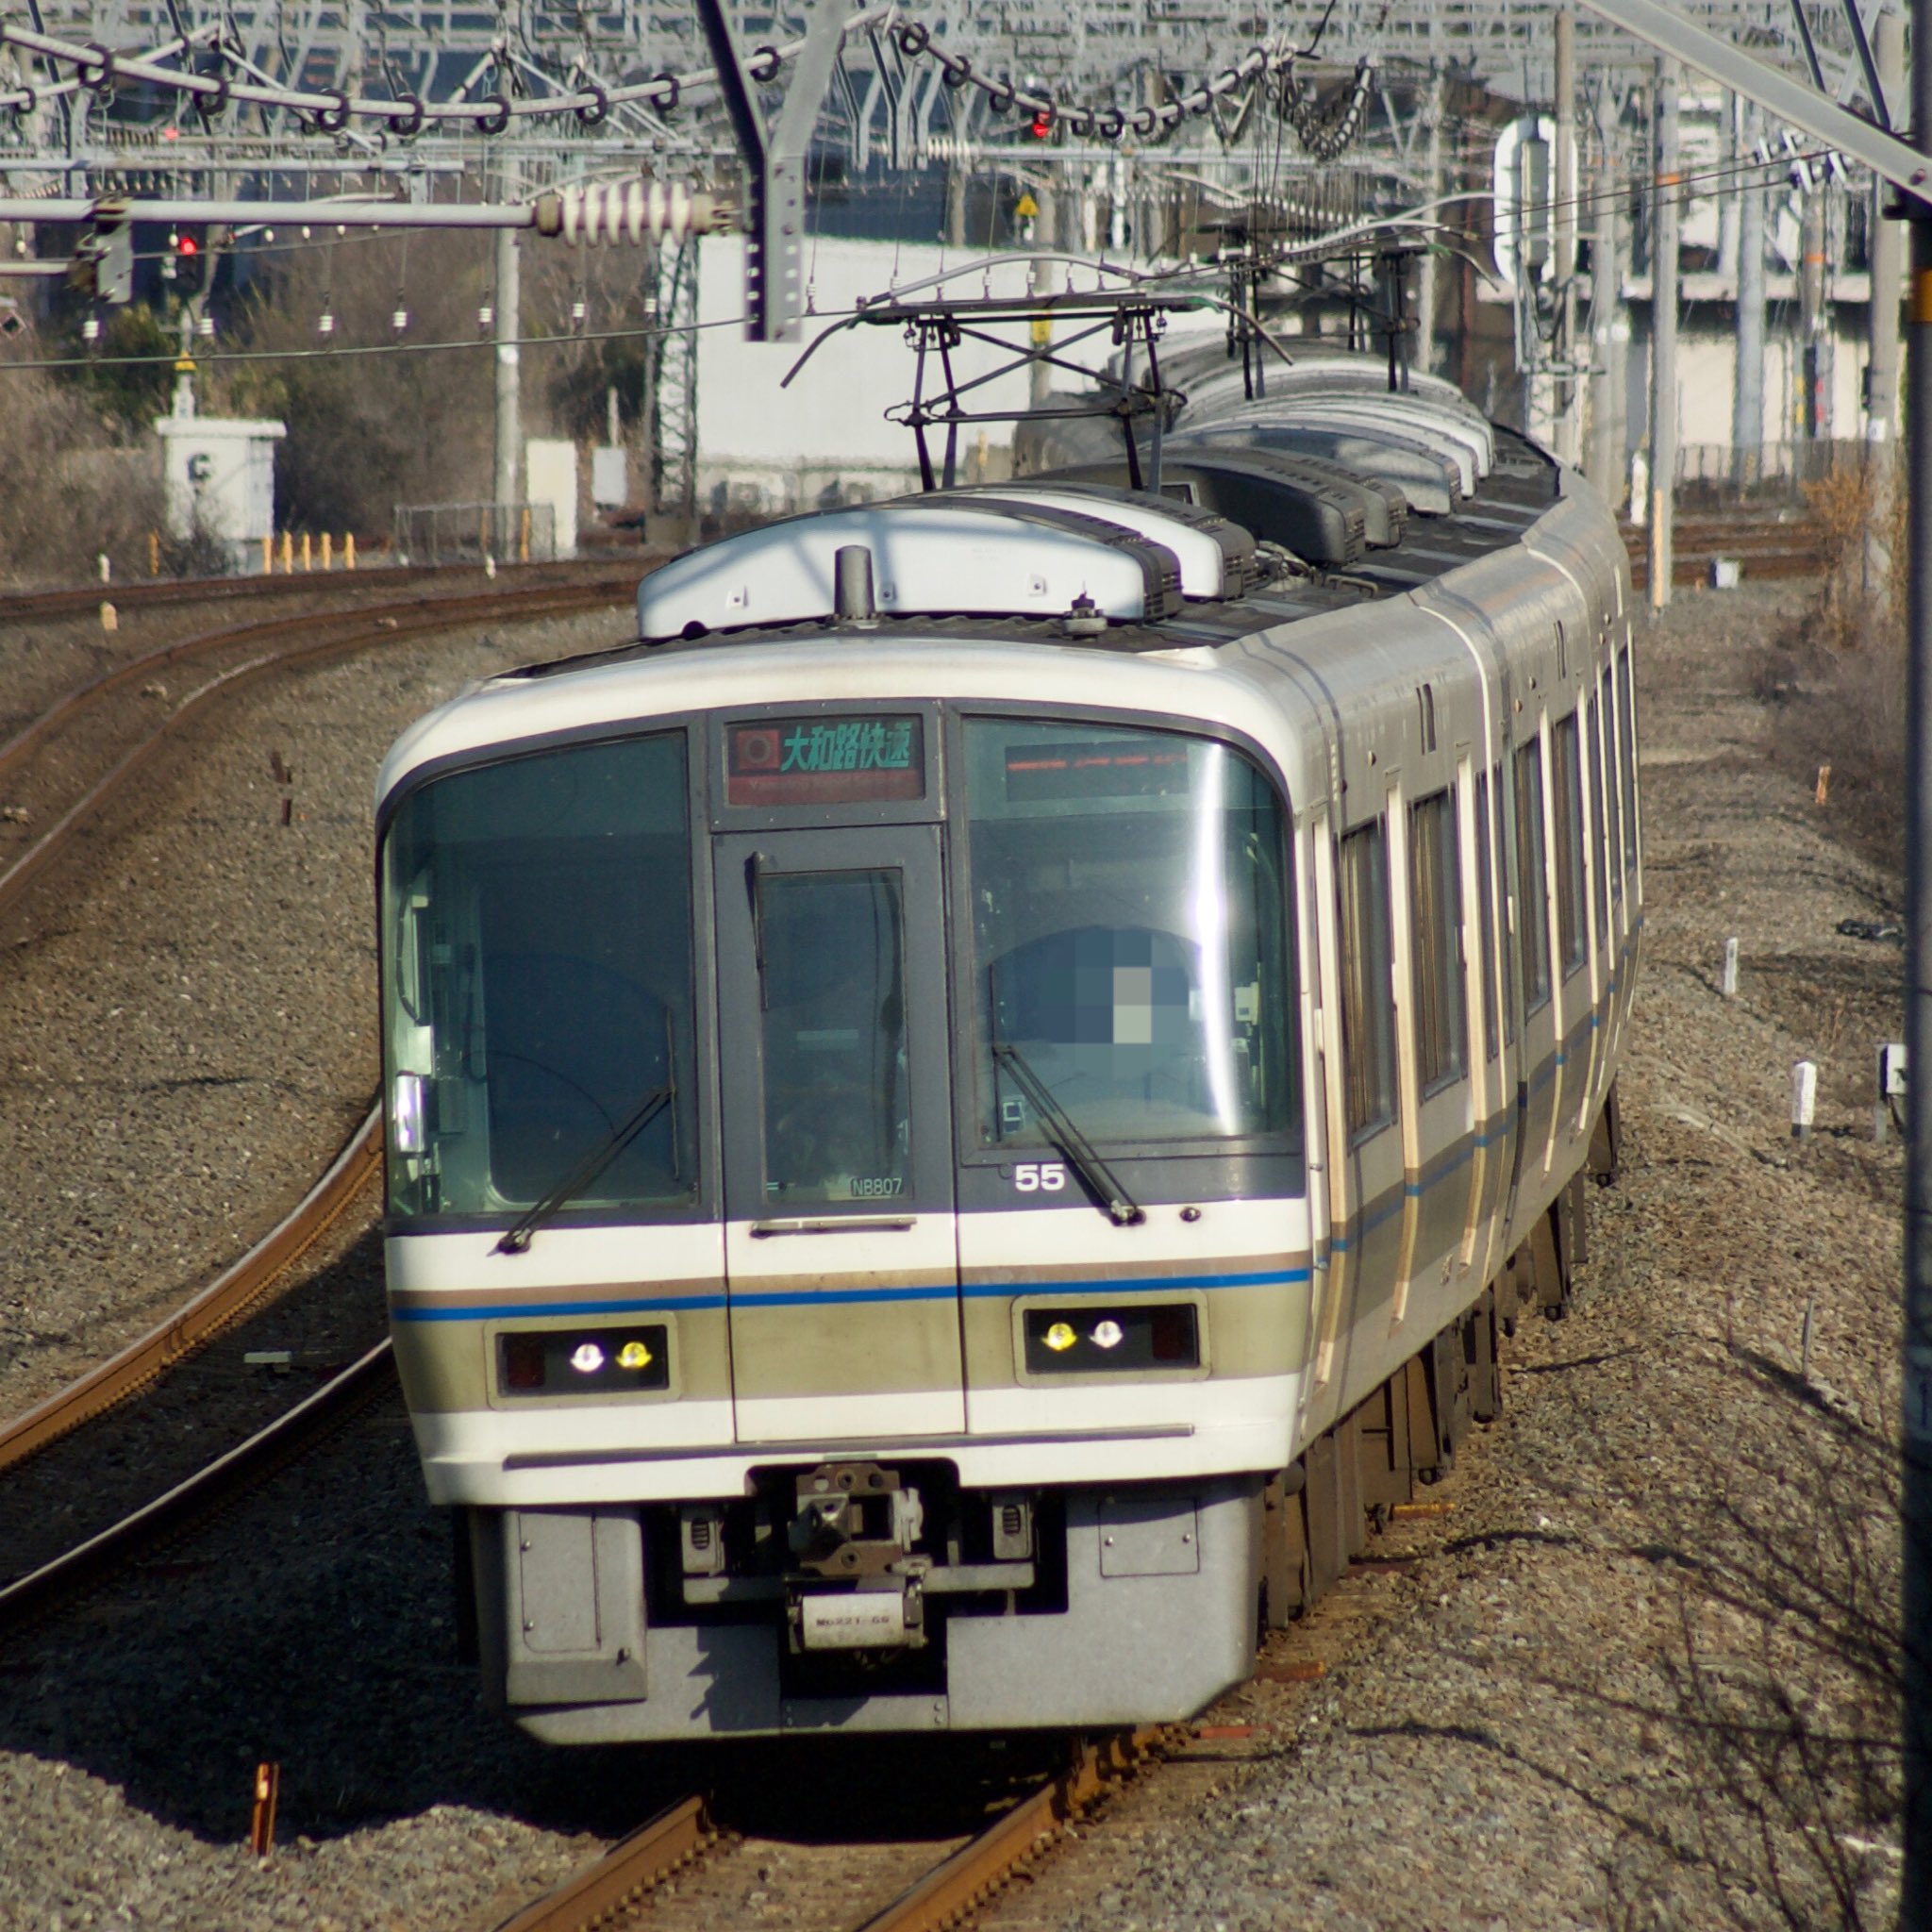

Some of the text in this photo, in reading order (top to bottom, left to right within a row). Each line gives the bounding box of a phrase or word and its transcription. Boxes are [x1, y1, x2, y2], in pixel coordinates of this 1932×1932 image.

[782, 723, 912, 771] 大和路快速
[852, 1177, 903, 1196] NB807
[1014, 1163, 1066, 1192] 55
